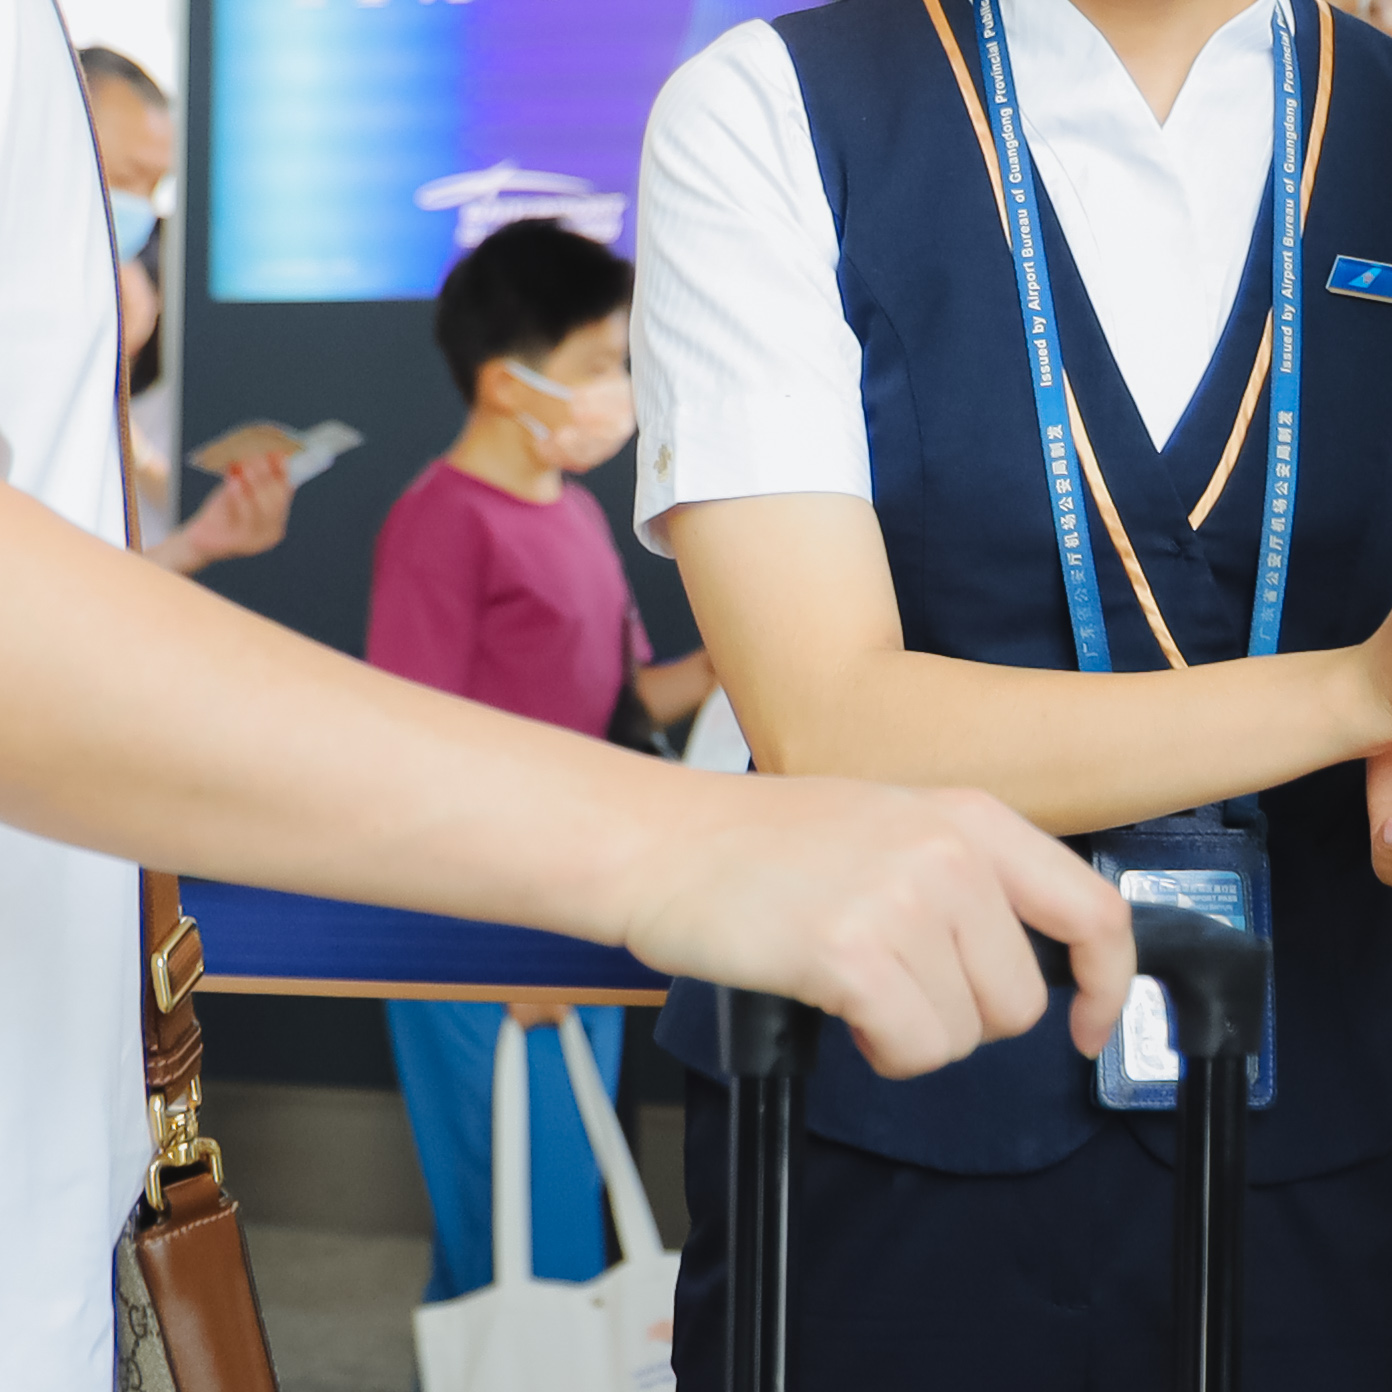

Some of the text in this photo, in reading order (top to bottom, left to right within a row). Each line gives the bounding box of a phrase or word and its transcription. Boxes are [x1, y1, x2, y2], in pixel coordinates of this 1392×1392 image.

[987, 41, 1008, 104] Provincial
[1279, 30, 1295, 94] Provincial
[1001, 107, 1023, 184] Guangdong
[1283, 97, 1298, 173] Guangdong
[1010, 188, 1025, 203] of
[1284, 178, 1295, 193] of
[1018, 208, 1034, 258] Bureau
[1282, 197, 1296, 247] Bureau
[1023, 261, 1041, 311] Airport
[1281, 250, 1296, 299] Airport
[1031, 315, 1047, 335] by
[1281, 303, 1296, 321] by
[1038, 338, 1054, 387] Issued
[1280, 325, 1293, 373] Issued
